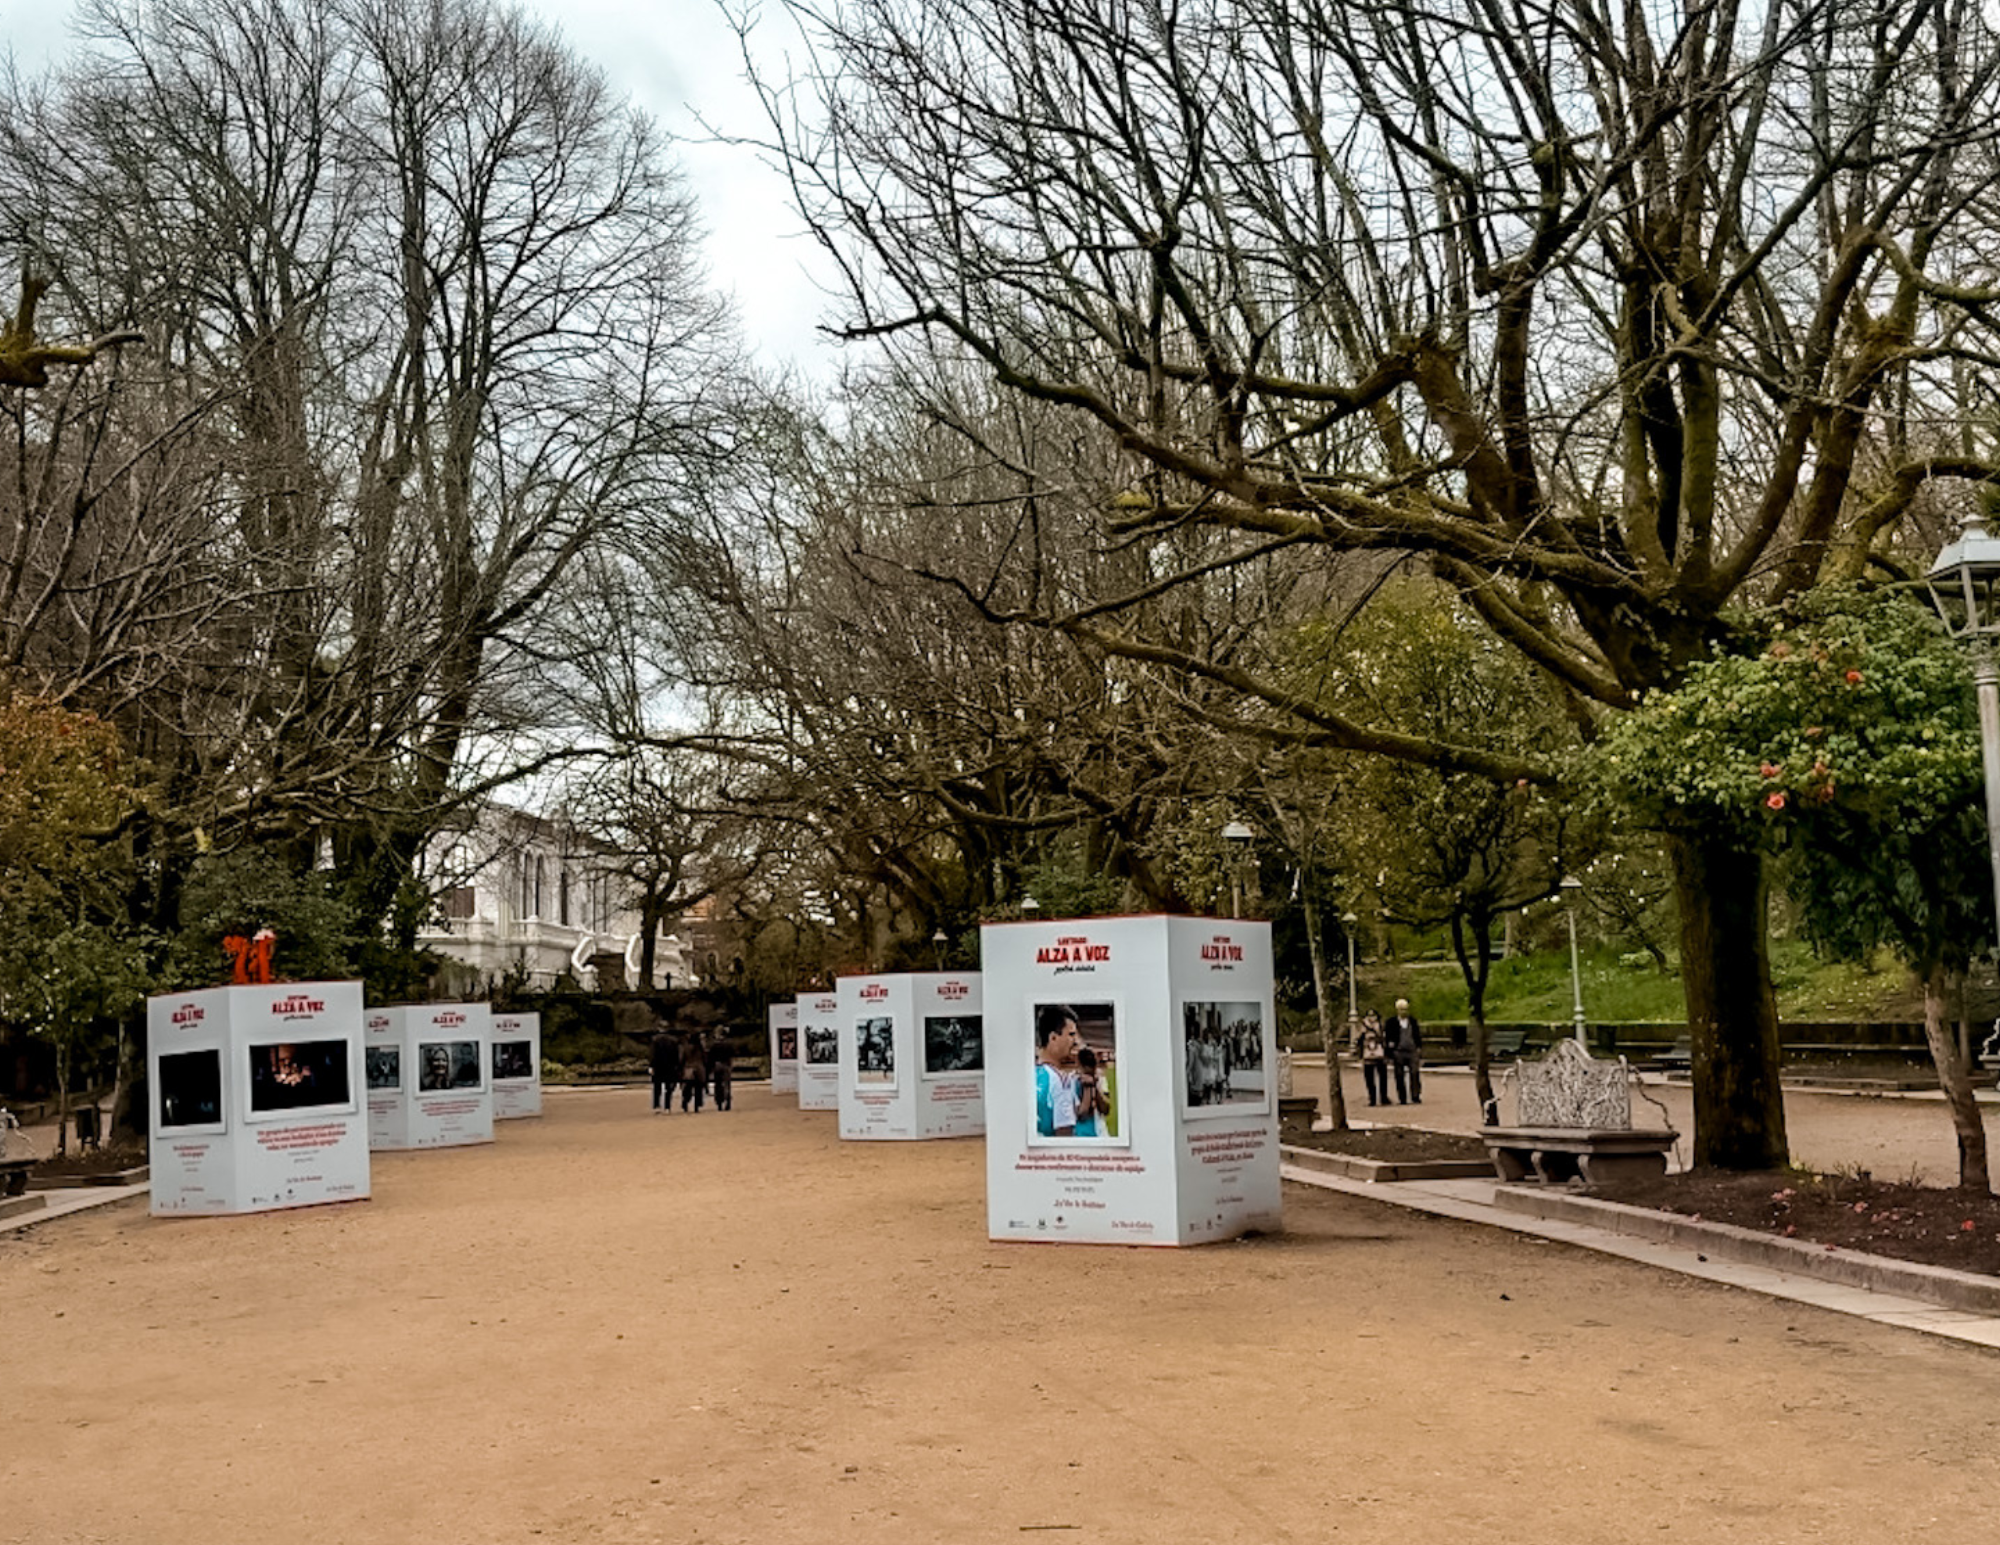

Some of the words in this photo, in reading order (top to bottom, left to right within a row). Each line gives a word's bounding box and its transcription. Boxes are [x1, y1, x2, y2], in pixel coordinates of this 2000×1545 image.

[1036, 947, 1069, 963] ALZA
[1073, 946, 1082, 962] A
[1086, 945, 1110, 961] VOZ
